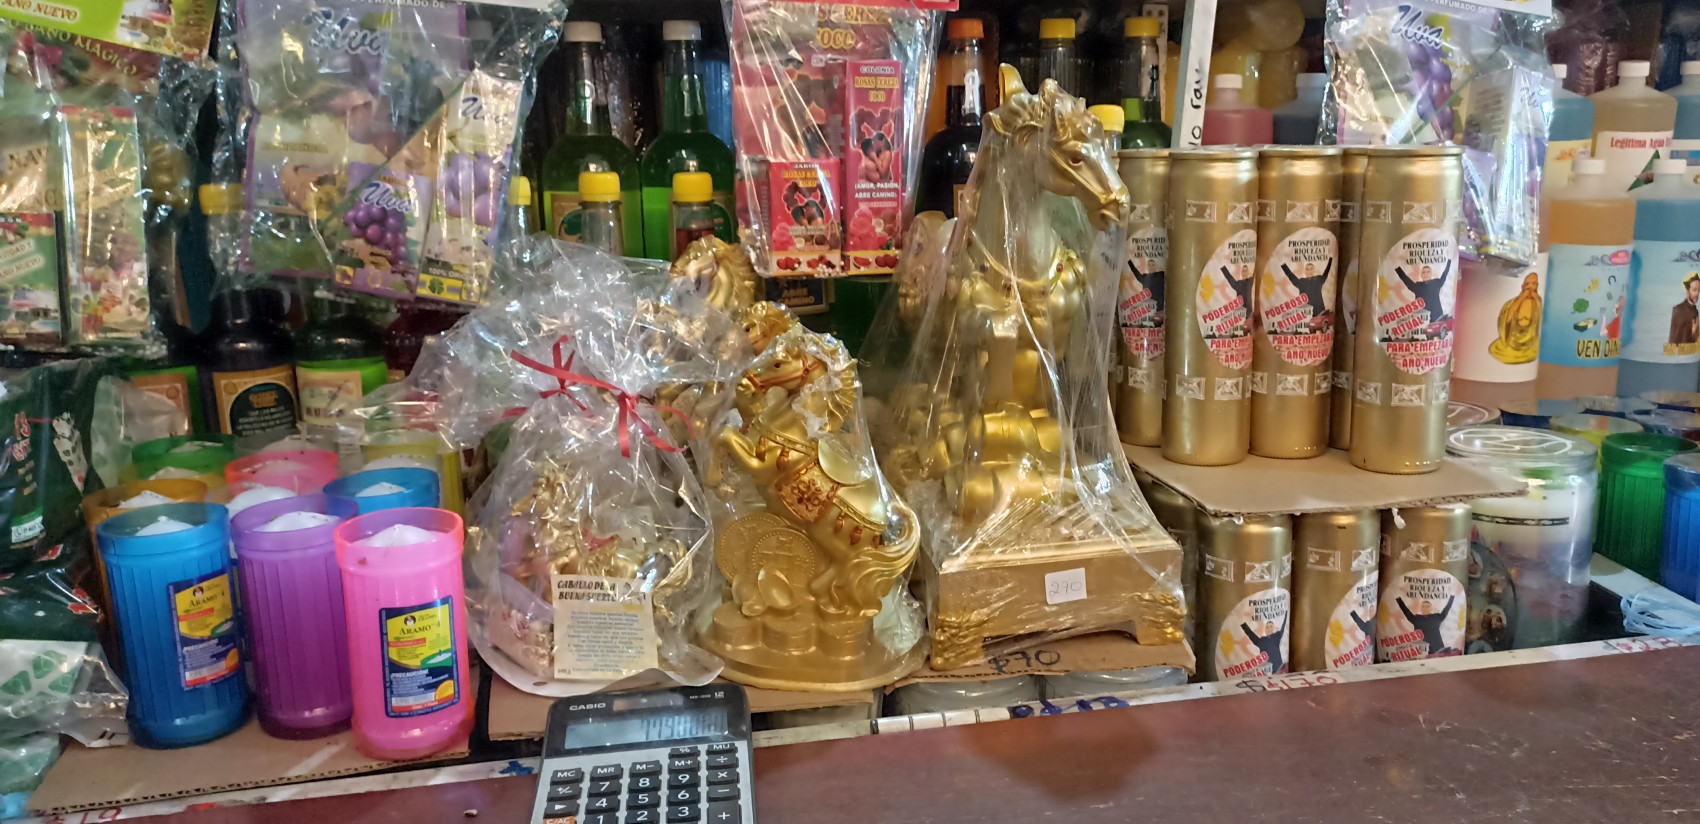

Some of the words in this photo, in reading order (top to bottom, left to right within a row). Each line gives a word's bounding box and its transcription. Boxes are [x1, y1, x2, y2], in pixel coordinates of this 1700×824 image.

[33, 3, 78, 21] NUEVO
[860, 65, 896, 74] COLONIA
[1288, 239, 1330, 247] PROSPERIDAD
[1403, 240, 1448, 249] PROSPERIDAD
[1294, 247, 1321, 255] RIQUEZA
[1409, 249, 1439, 257] RIQUEZA
[1202, 296, 1243, 323] PODEROSO
[1265, 293, 1308, 320] PODEROSO
[1378, 298, 1425, 326] PODEROSO
[1216, 316, 1243, 333] RITUAL
[1277, 311, 1307, 331] RITUAL
[1391, 317, 1424, 337] RITUAL
[1272, 335, 1294, 345] PARA
[1386, 342, 1411, 353] PARA
[1414, 339, 1449, 352] EMPEZAR
[1577, 340, 1600, 358] VEN
[1424, 355, 1447, 367] NUEVO
[558, 580, 592, 589] CABALLO
[1404, 575, 1451, 585] PROSPERIDAD
[1049, 581, 1082, 596] 270
[1409, 584, 1440, 593] RIQUEZA
[558, 592, 585, 600] BUENA
[400, 624, 431, 635] ARAMO
[1380, 629, 1425, 647] PODEROSO
[1333, 636, 1372, 668] PODEROSO
[1391, 647, 1422, 661] RITUAL
[1223, 652, 1269, 678] PODEROSO
[569, 702, 606, 711] CASIO
[557, 770, 575, 778] MC
[597, 767, 614, 775] MR
[638, 778, 650, 787] 8
[678, 774, 690, 784] 9
[600, 782, 610, 791] 7
[638, 794, 649, 804] 5
[678, 790, 690, 800] 6
[595, 798, 607, 808] 4
[637, 811, 648, 821] 2
[678, 807, 689, 817] 3
[597, 815, 604, 824] 1
